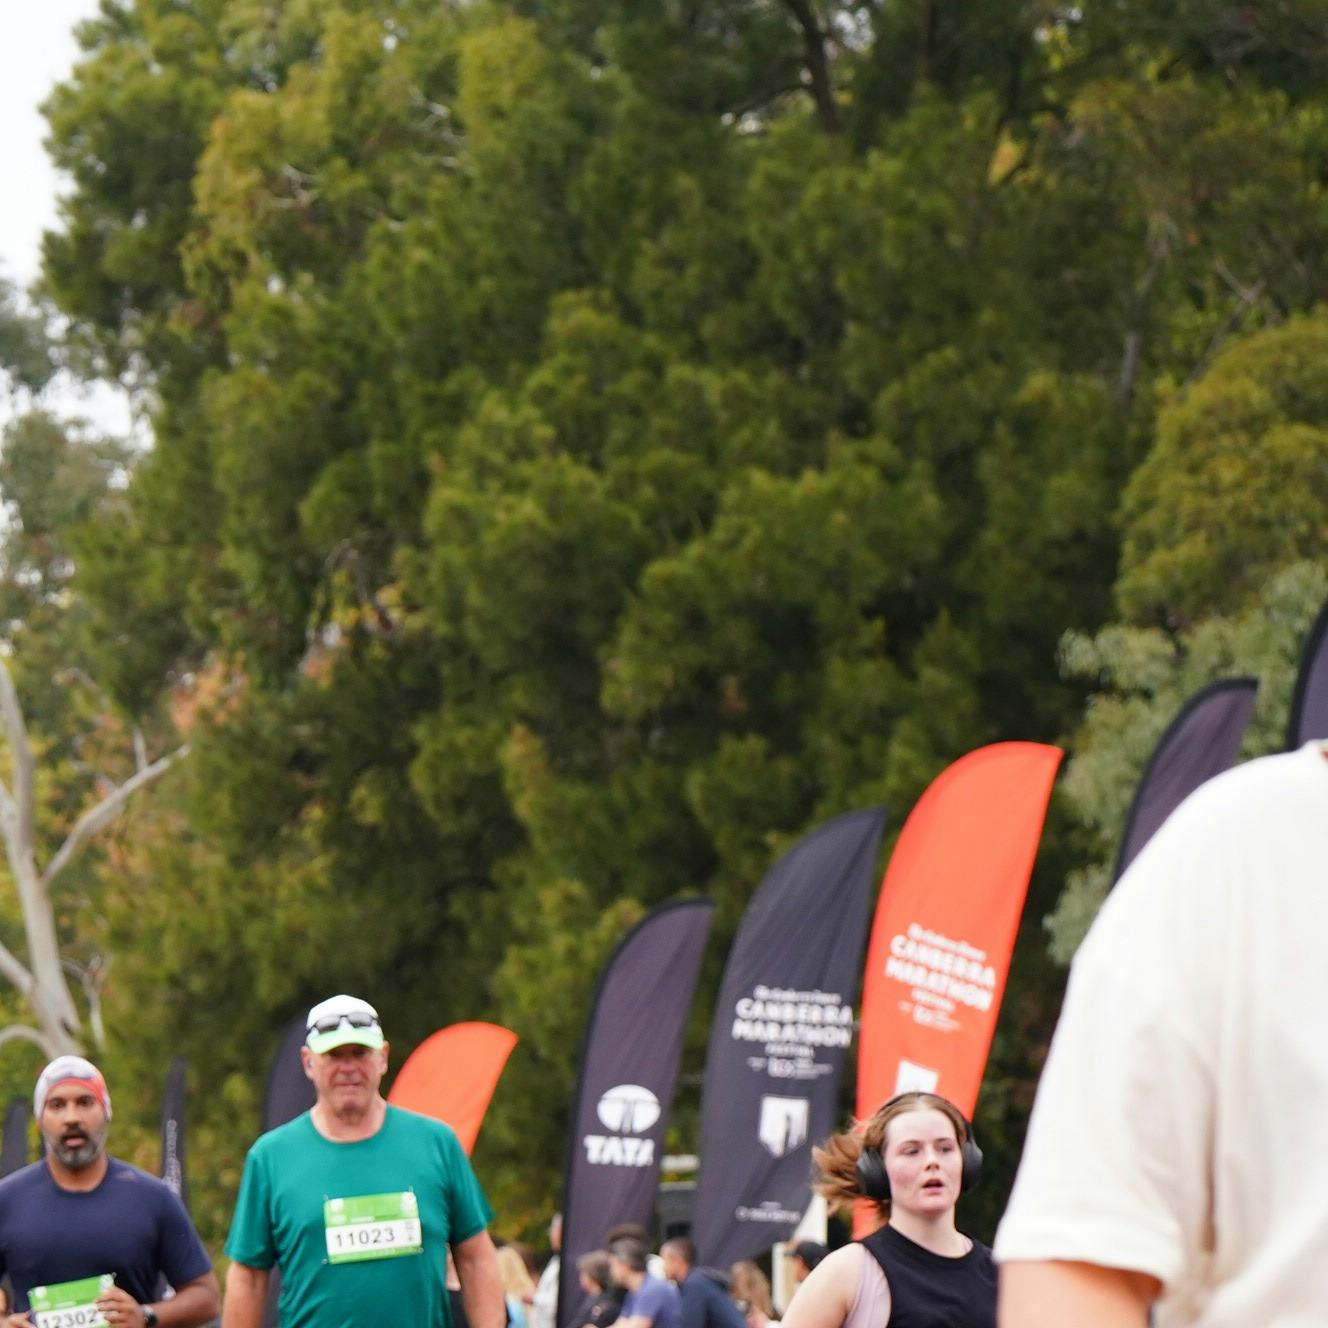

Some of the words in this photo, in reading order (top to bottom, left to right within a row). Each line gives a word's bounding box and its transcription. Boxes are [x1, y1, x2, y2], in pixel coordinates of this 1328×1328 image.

[889, 934, 997, 991] CANBERRA
[884, 956, 994, 1011] MARATHON
[735, 998, 853, 1024] CANBERRA
[731, 1018, 853, 1048] MARATHON
[584, 1134, 655, 1167] TATA
[337, 1228, 395, 1247] 11023
